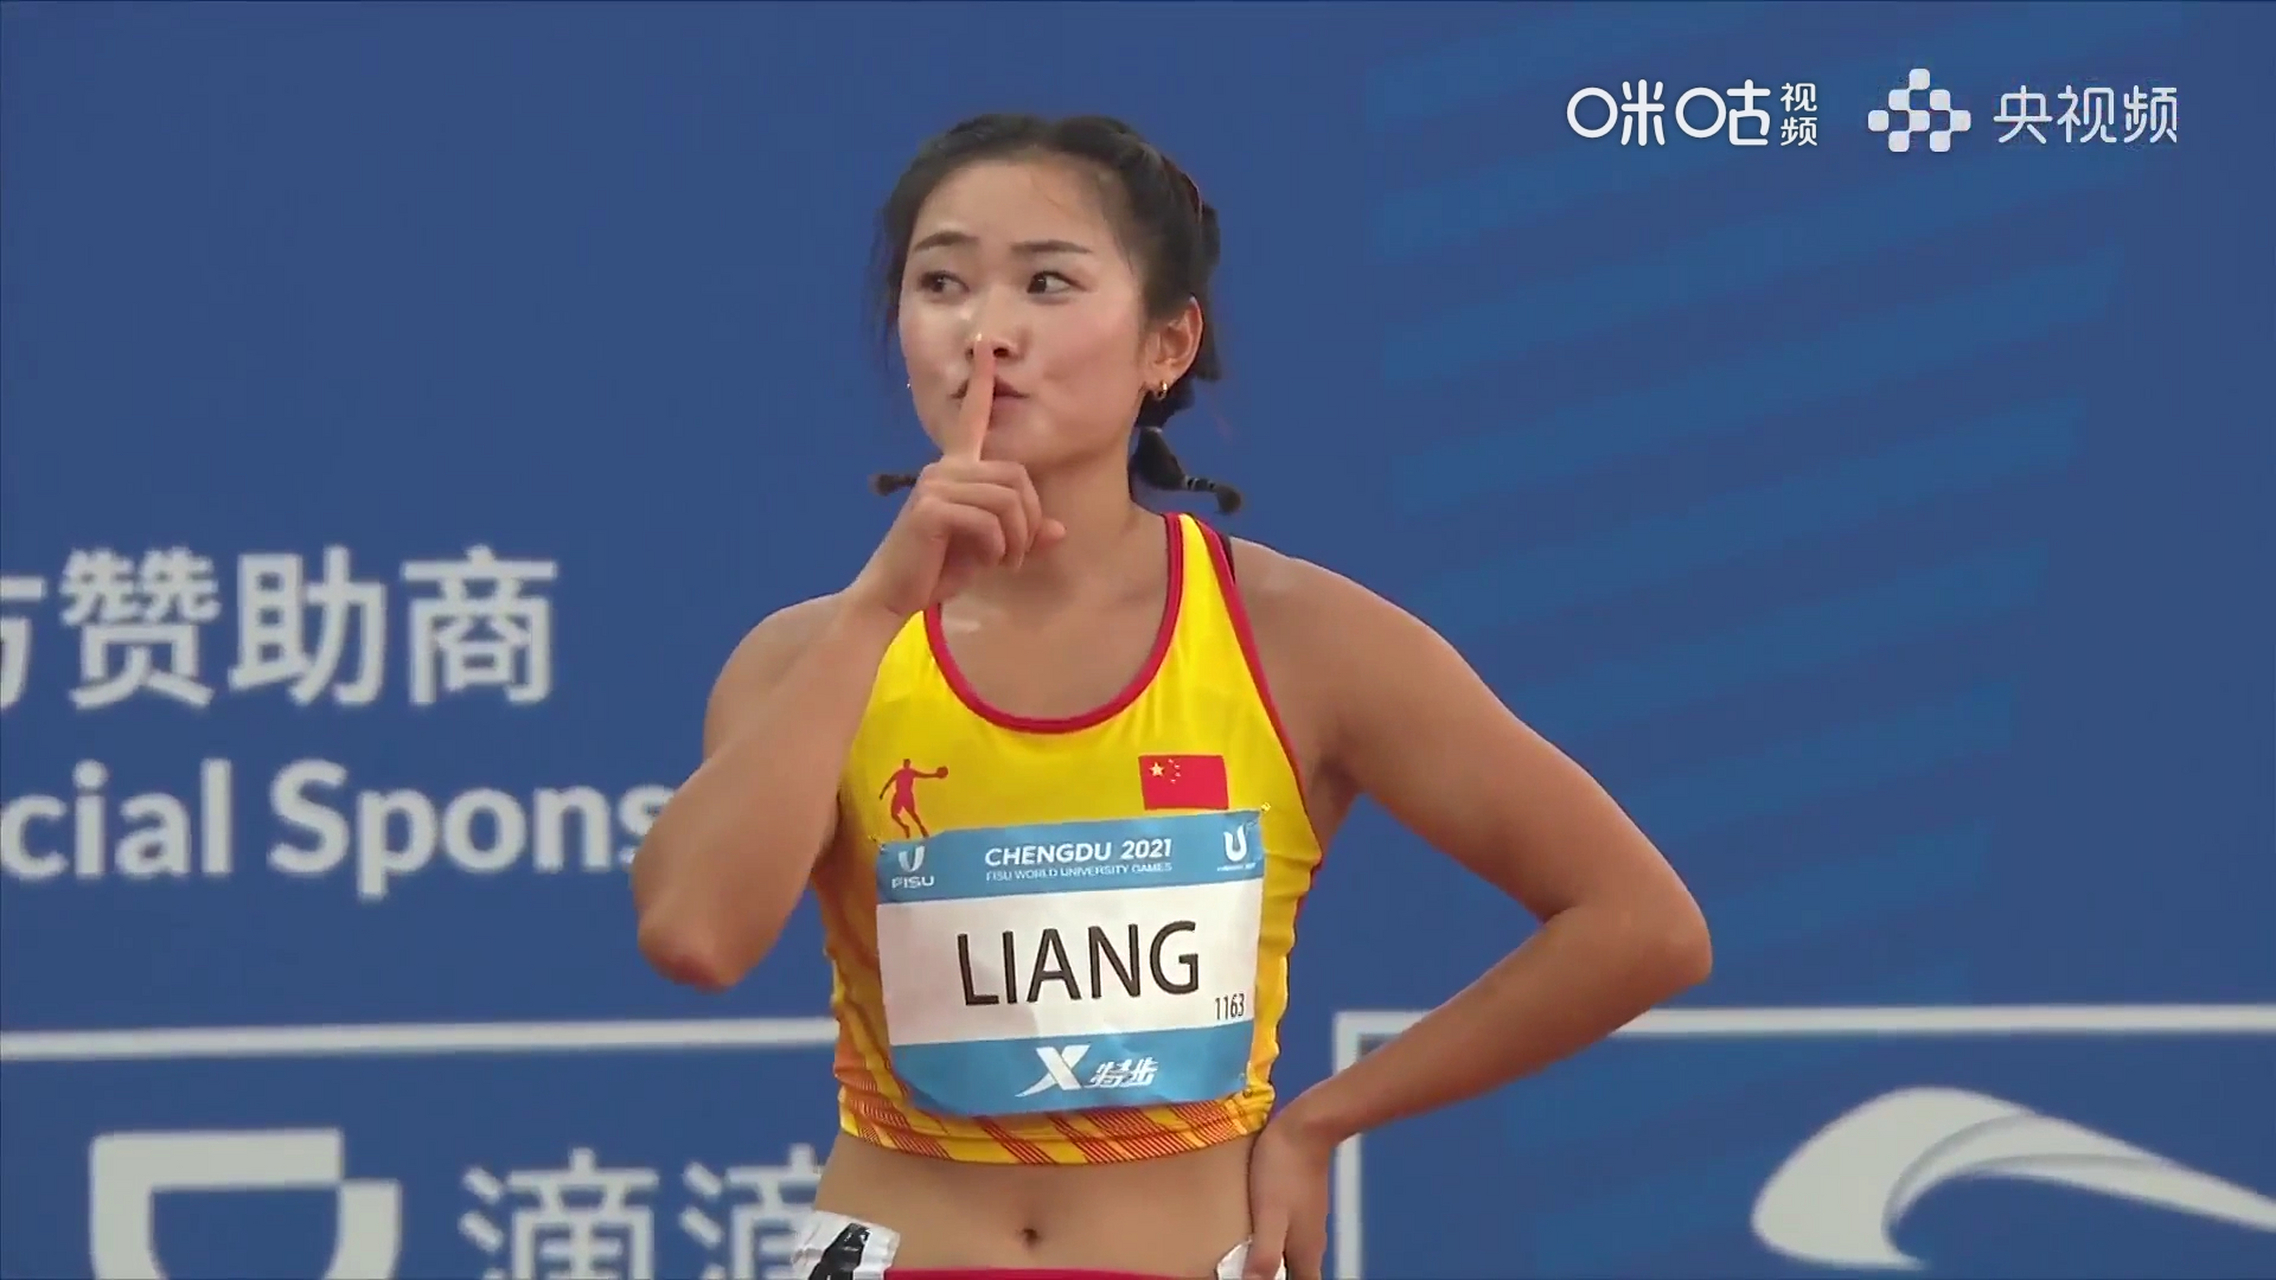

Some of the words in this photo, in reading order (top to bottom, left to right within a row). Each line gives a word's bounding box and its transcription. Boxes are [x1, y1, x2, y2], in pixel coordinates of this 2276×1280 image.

[0, 758, 233, 878] cial
[984, 841, 1112, 868] CHENGDU
[1119, 838, 1172, 860] 2021
[891, 875, 935, 890] FISU
[1014, 867, 1059, 880] WORLD
[1060, 863, 1129, 878] UNIVERSITY
[1131, 862, 1173, 875] GAMES
[957, 920, 1200, 1007] LIANG
[1214, 992, 1246, 1021] 1163
[1084, 1056, 1159, 1090] 特步
